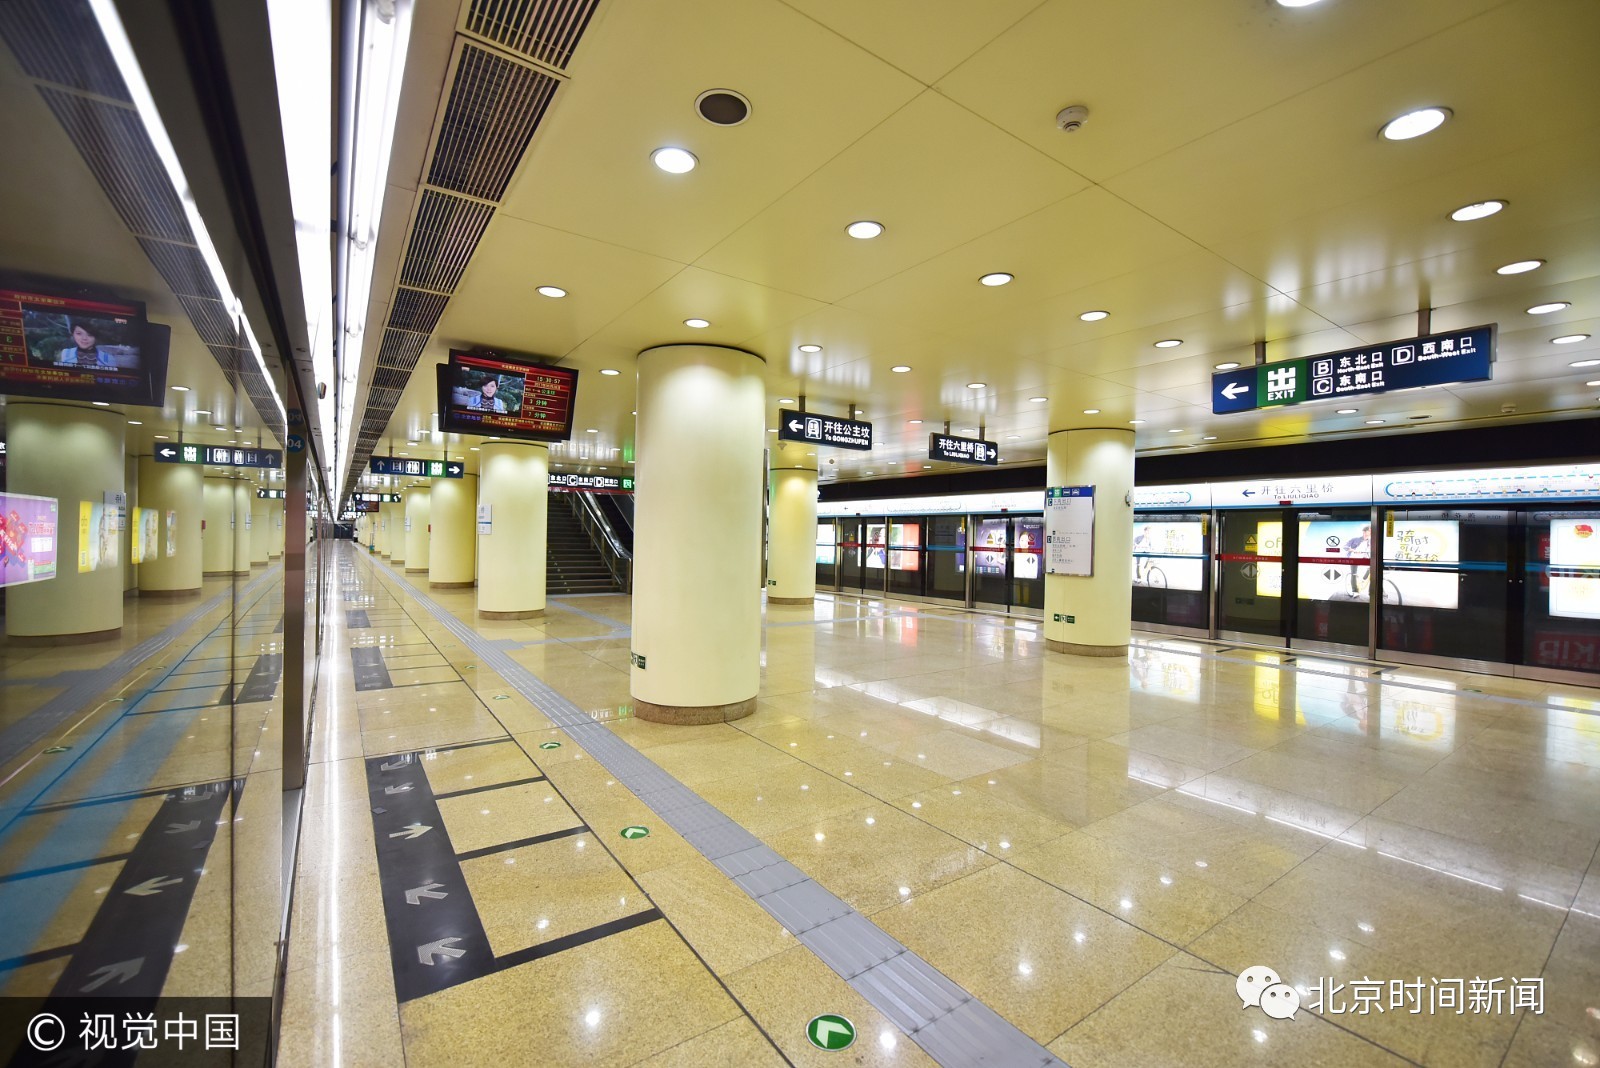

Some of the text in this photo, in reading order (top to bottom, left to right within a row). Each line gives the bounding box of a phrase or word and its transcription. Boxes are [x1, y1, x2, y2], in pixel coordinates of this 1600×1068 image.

[1422, 337, 1472, 355] 西南口
[1461, 347, 1477, 355] Exit
[1339, 352, 1382, 368] 东北口
[1396, 348, 1411, 363] D
[1317, 362, 1330, 375] B
[1339, 370, 1382, 386] 东南口
[1316, 379, 1330, 393] C
[1268, 389, 1296, 401] EXIT
[824, 421, 870, 438] 开往公主坟
[287, 438, 302, 448] 04
[939, 438, 974, 453] 开往六里桥
[569, 476, 576, 484] C
